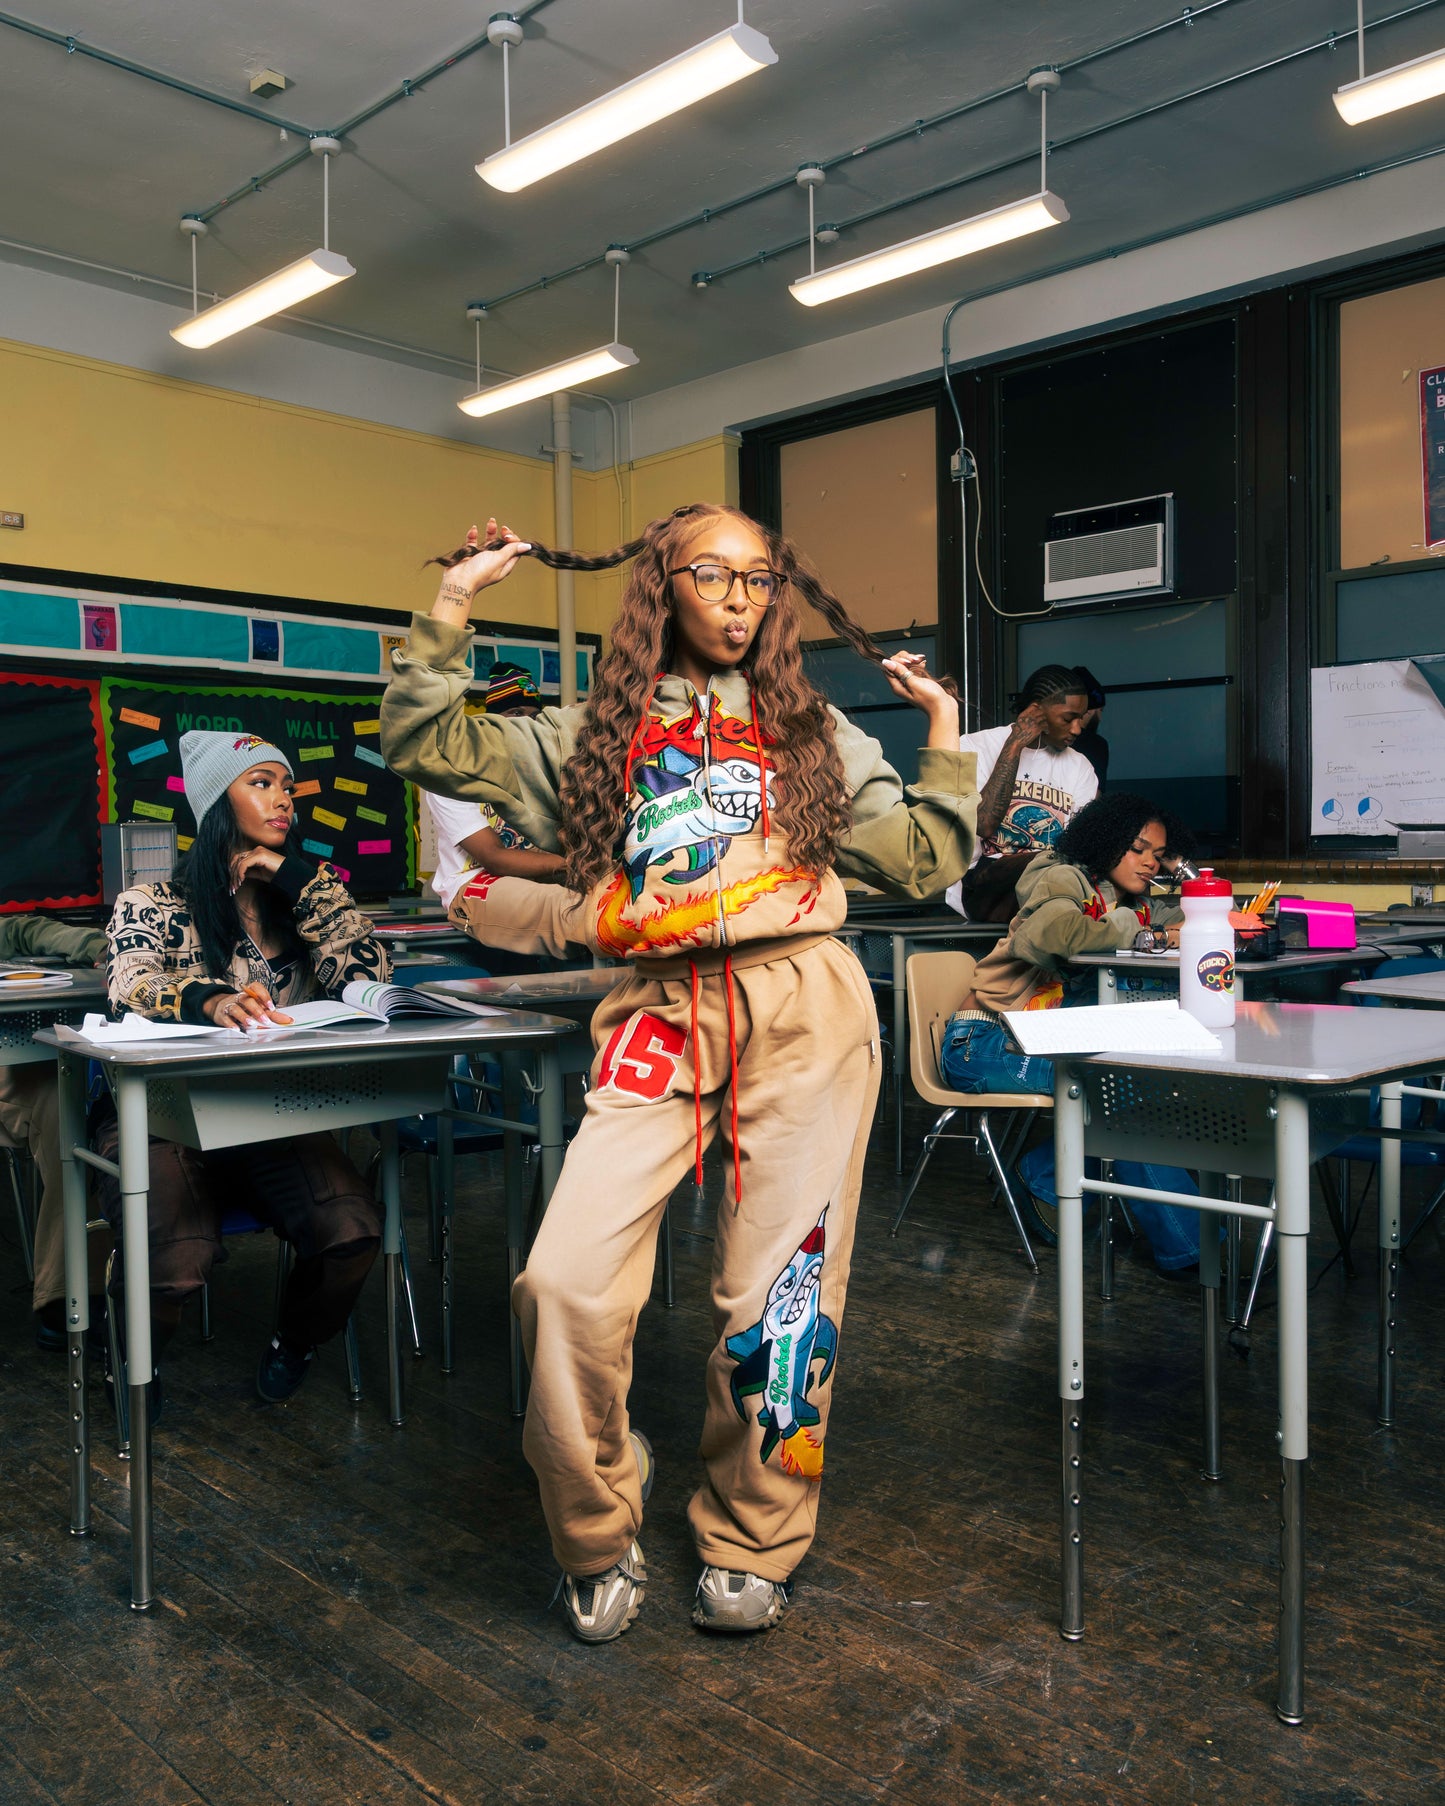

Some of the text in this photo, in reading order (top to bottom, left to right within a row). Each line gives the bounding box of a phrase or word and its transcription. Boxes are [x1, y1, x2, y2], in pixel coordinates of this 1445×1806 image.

[387, 637, 401, 645] JOY
[176, 712, 243, 733] WORD
[285, 719, 340, 740] WALL
[1012, 780, 1073, 815] CKEDUP
[637, 789, 702, 842] Rockets
[1198, 957, 1227, 973] STOCKS
[596, 1013, 688, 1103] 15
[769, 1333, 792, 1406] Rockets
